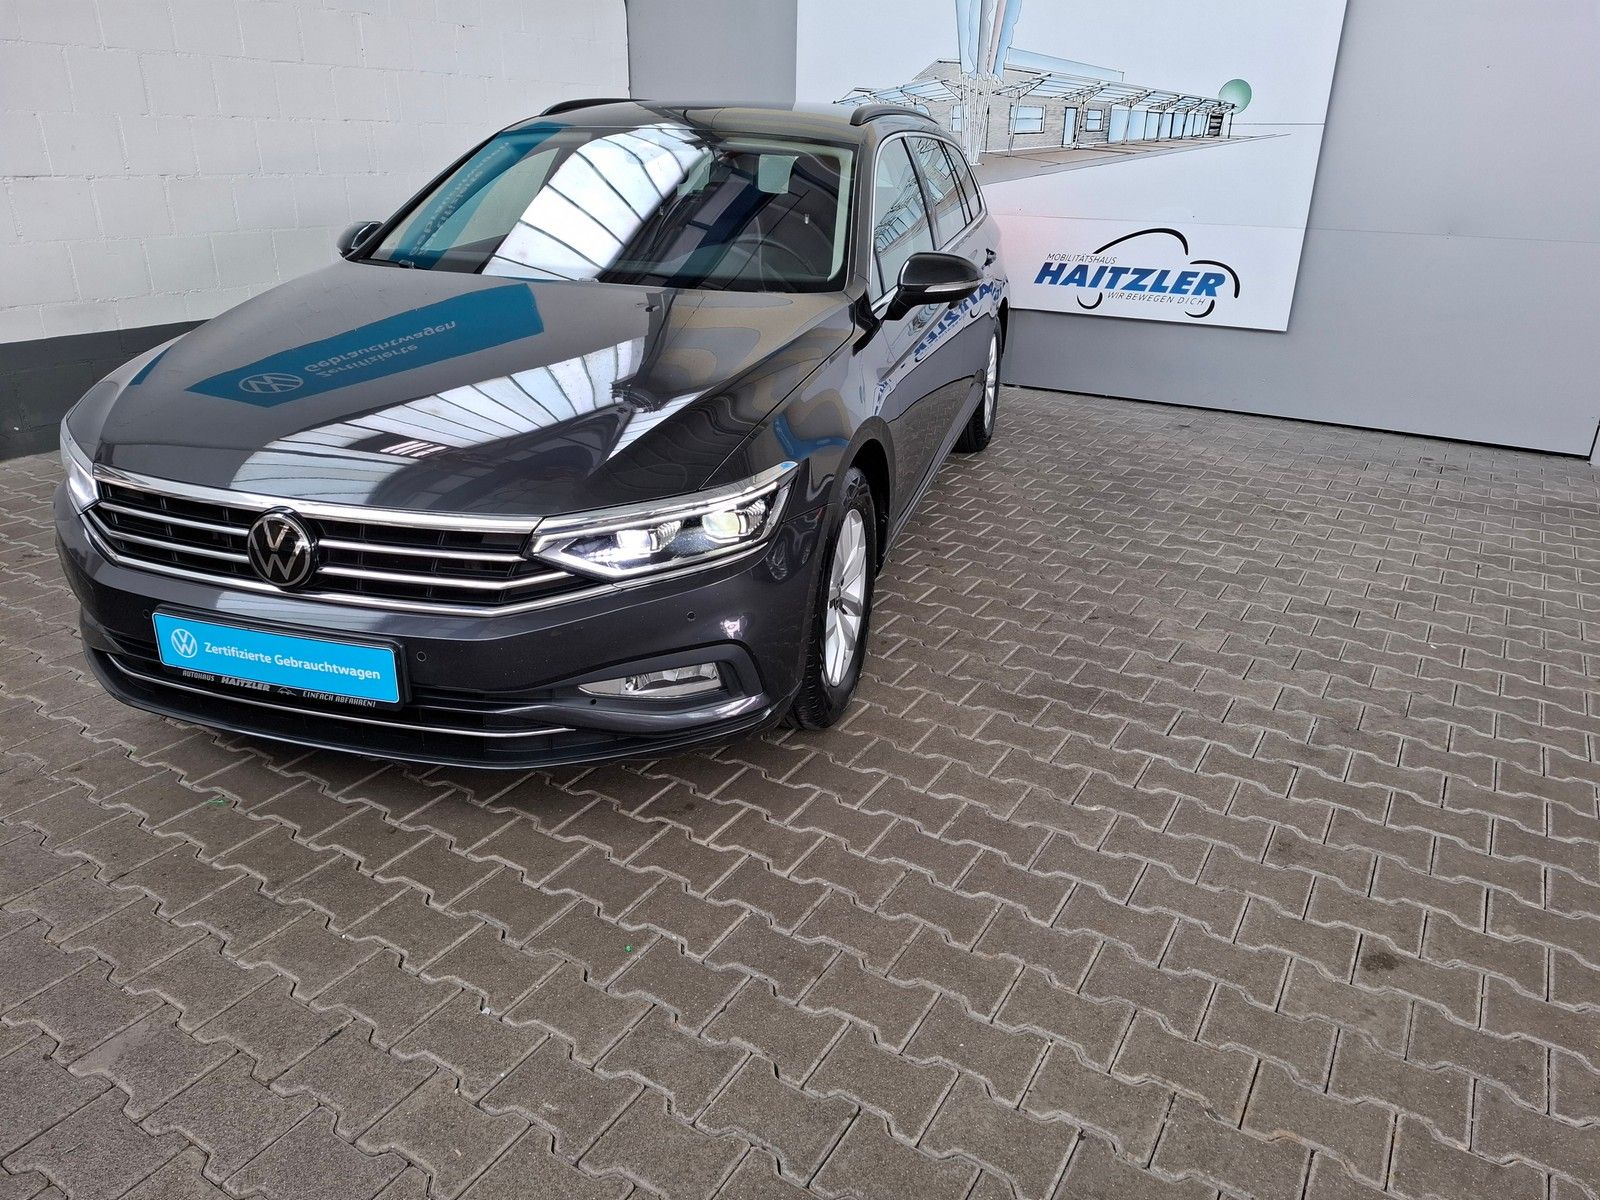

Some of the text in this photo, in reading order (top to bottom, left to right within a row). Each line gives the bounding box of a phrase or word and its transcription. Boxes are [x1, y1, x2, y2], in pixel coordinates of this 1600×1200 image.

[1046, 252, 1117, 264] MOBILITÄTSHAUS
[1034, 262, 1226, 297] HAITZLER
[1107, 291, 1206, 305] WIR BEWEGEN DICH
[204, 642, 381, 680] Zertifizierte Gebrauchtwagen
[182, 670, 376, 708] AUTOHAUS HAITZLER EINFACH ABFAHREN!
